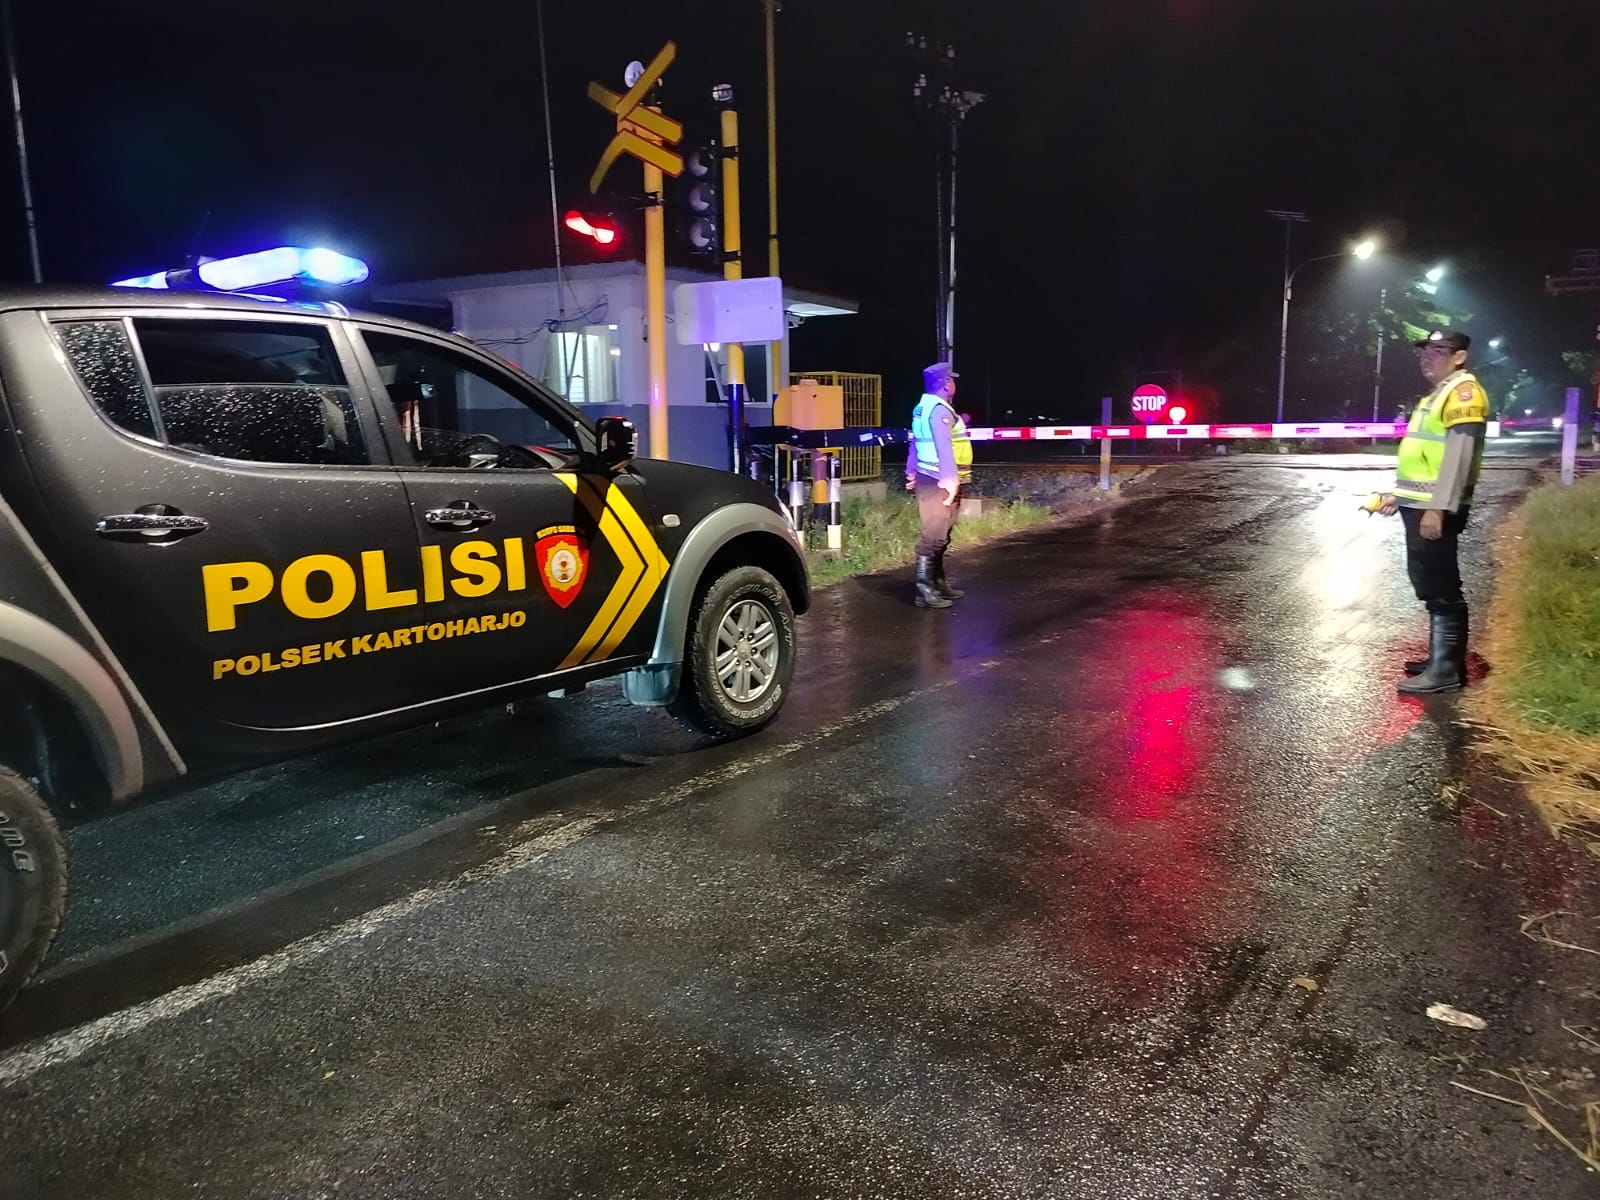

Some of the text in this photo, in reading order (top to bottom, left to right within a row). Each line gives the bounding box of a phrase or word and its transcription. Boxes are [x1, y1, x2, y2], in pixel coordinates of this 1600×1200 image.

[1132, 396, 1166, 411] STOP
[202, 537, 527, 633] POLISI
[213, 610, 527, 680] POLSEK KARTOHARJO
